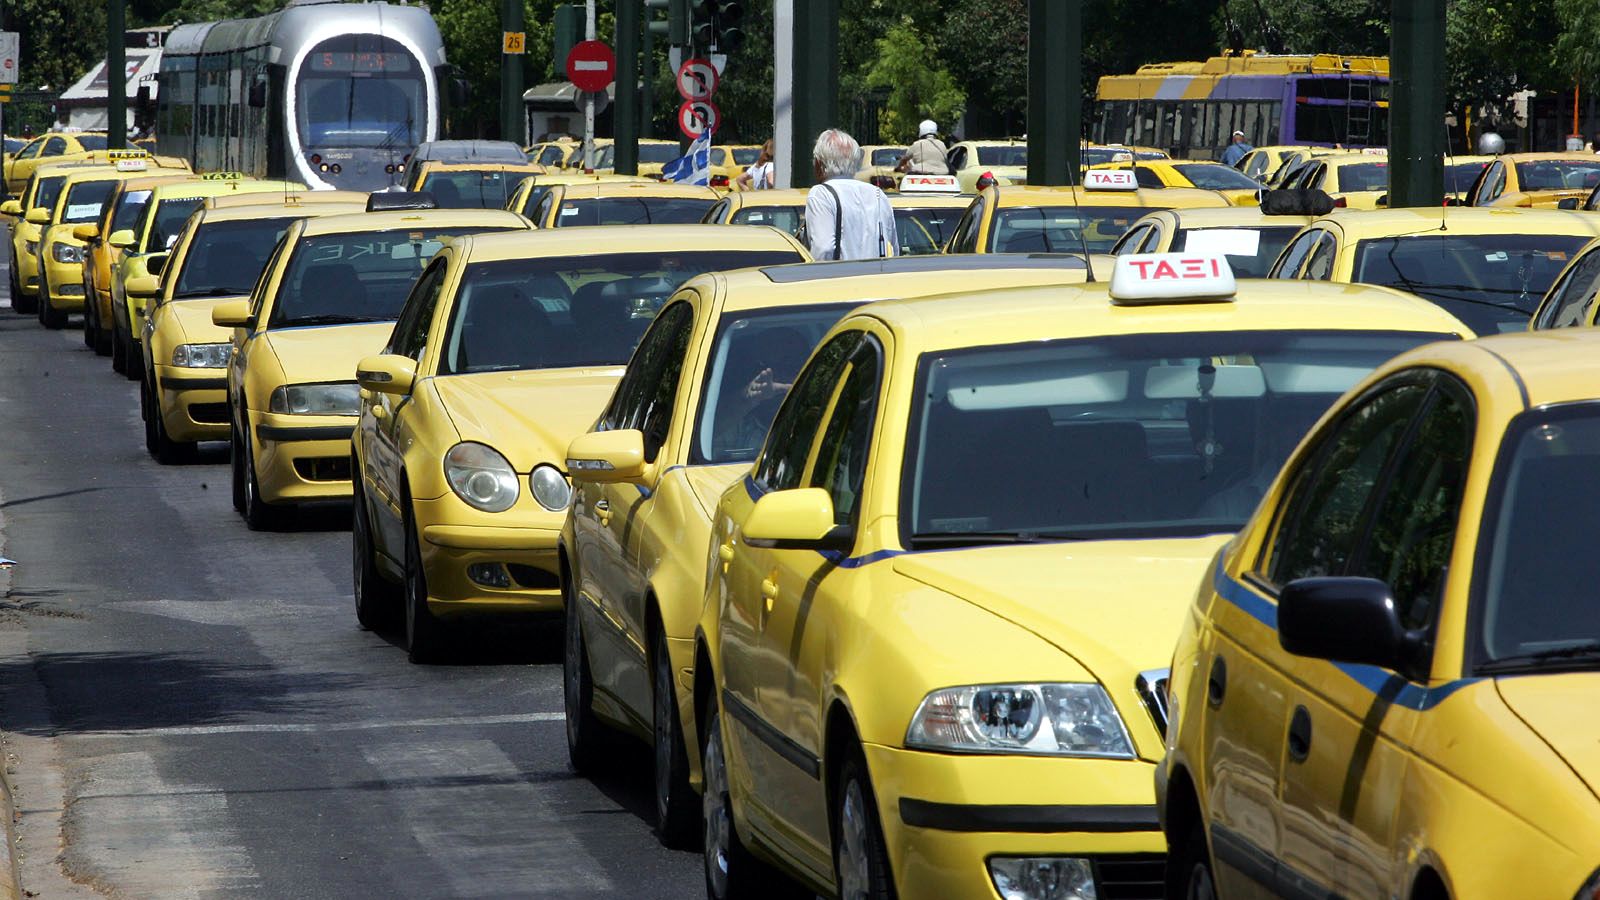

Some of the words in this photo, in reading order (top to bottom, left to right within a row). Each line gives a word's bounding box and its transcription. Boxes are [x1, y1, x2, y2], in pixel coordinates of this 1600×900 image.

[508, 37, 520, 48] 25
[205, 172, 242, 180] TAXI
[909, 177, 955, 185] ΤΑΞΙ
[1091, 174, 1132, 184] ΤΑΞΙ
[1128, 258, 1220, 280] ΤΑΞΙ
